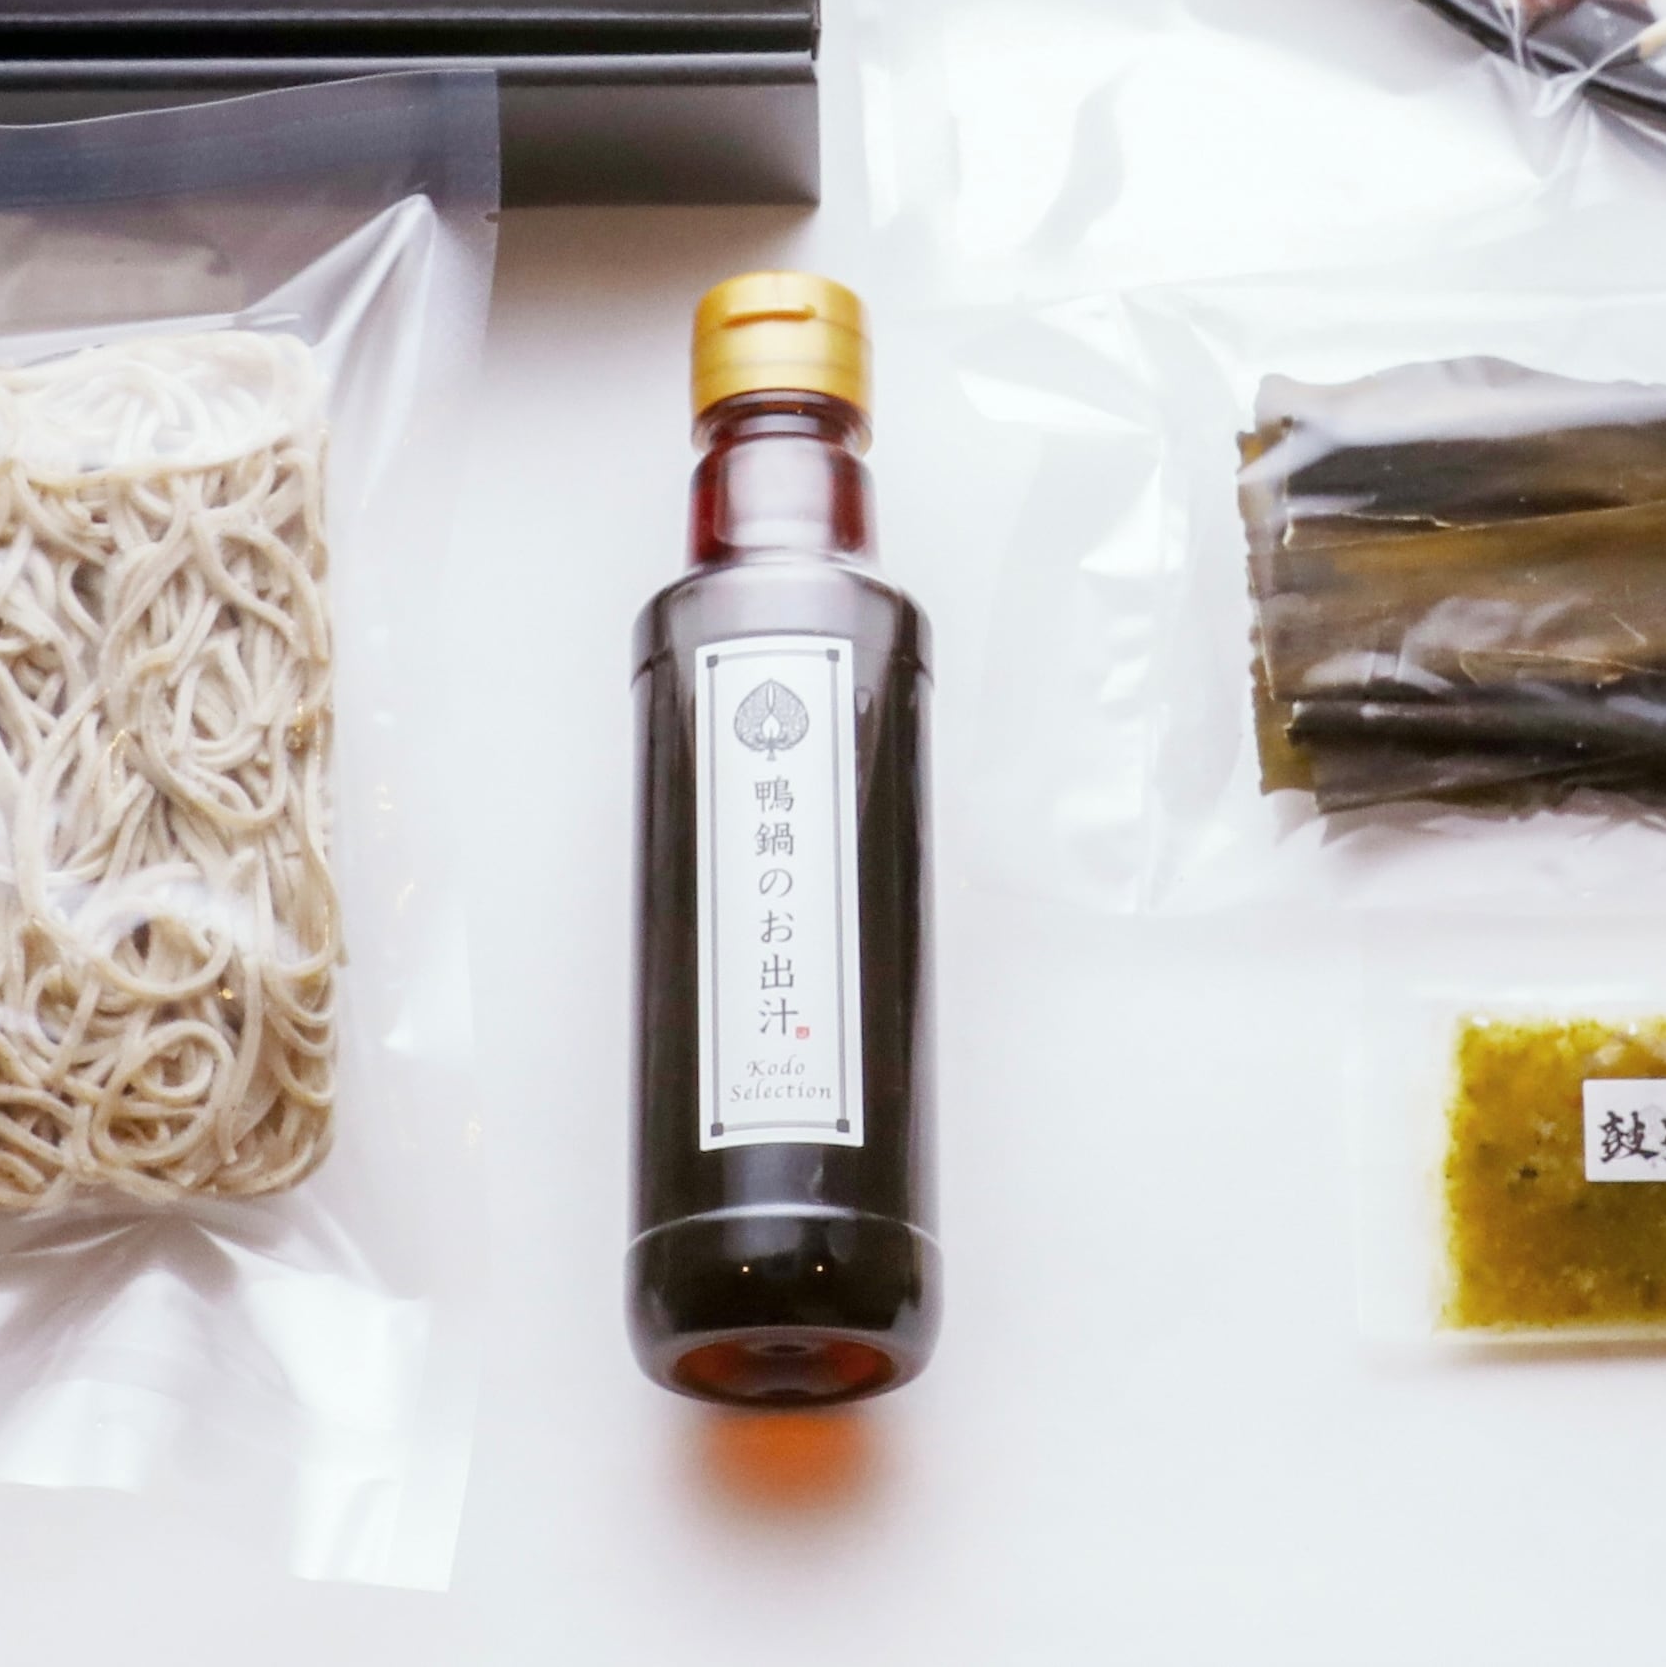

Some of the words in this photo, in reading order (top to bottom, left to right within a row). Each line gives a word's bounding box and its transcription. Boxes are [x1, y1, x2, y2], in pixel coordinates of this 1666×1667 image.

[754, 775, 799, 1036] 鴨鍋のお出汁
[747, 1054, 806, 1078] Kodo
[730, 1078, 832, 1102] Selection
